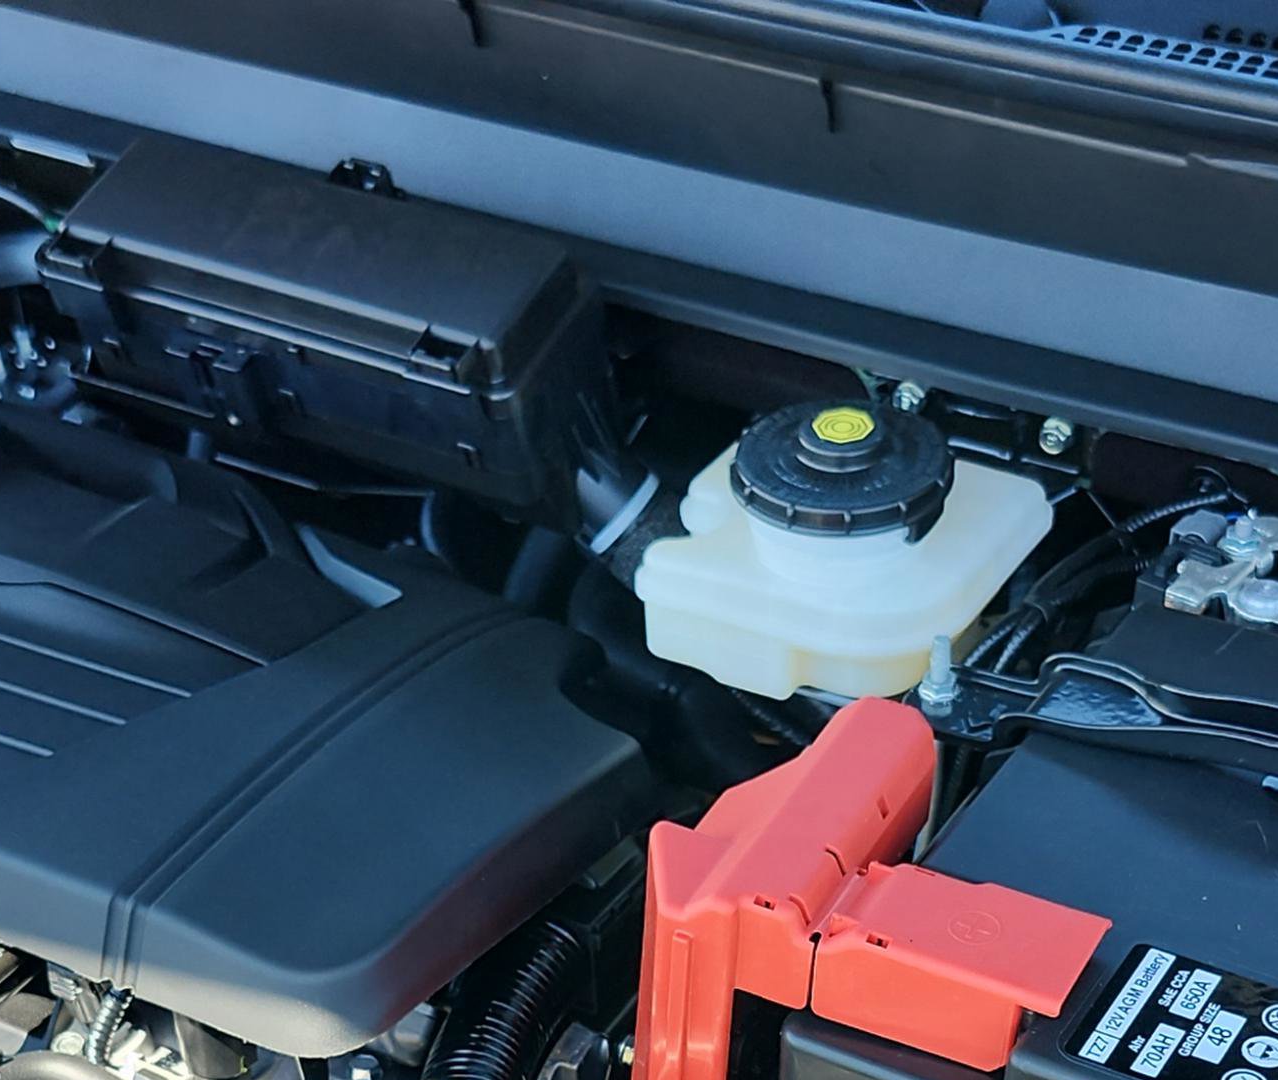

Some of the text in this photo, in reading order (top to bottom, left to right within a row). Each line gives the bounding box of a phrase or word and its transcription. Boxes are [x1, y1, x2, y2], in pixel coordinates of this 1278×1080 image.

[1105, 953, 1168, 1031] 12V AGM Battery
[1157, 970, 1191, 1007] SAE CCA
[1180, 981, 1212, 1010] 650A
[1086, 1036, 1109, 1058] TZ7
[1177, 1002, 1221, 1057] GROUP SIZE
[1207, 1026, 1232, 1047] 48
[1140, 1033, 1175, 1069] 70AH
